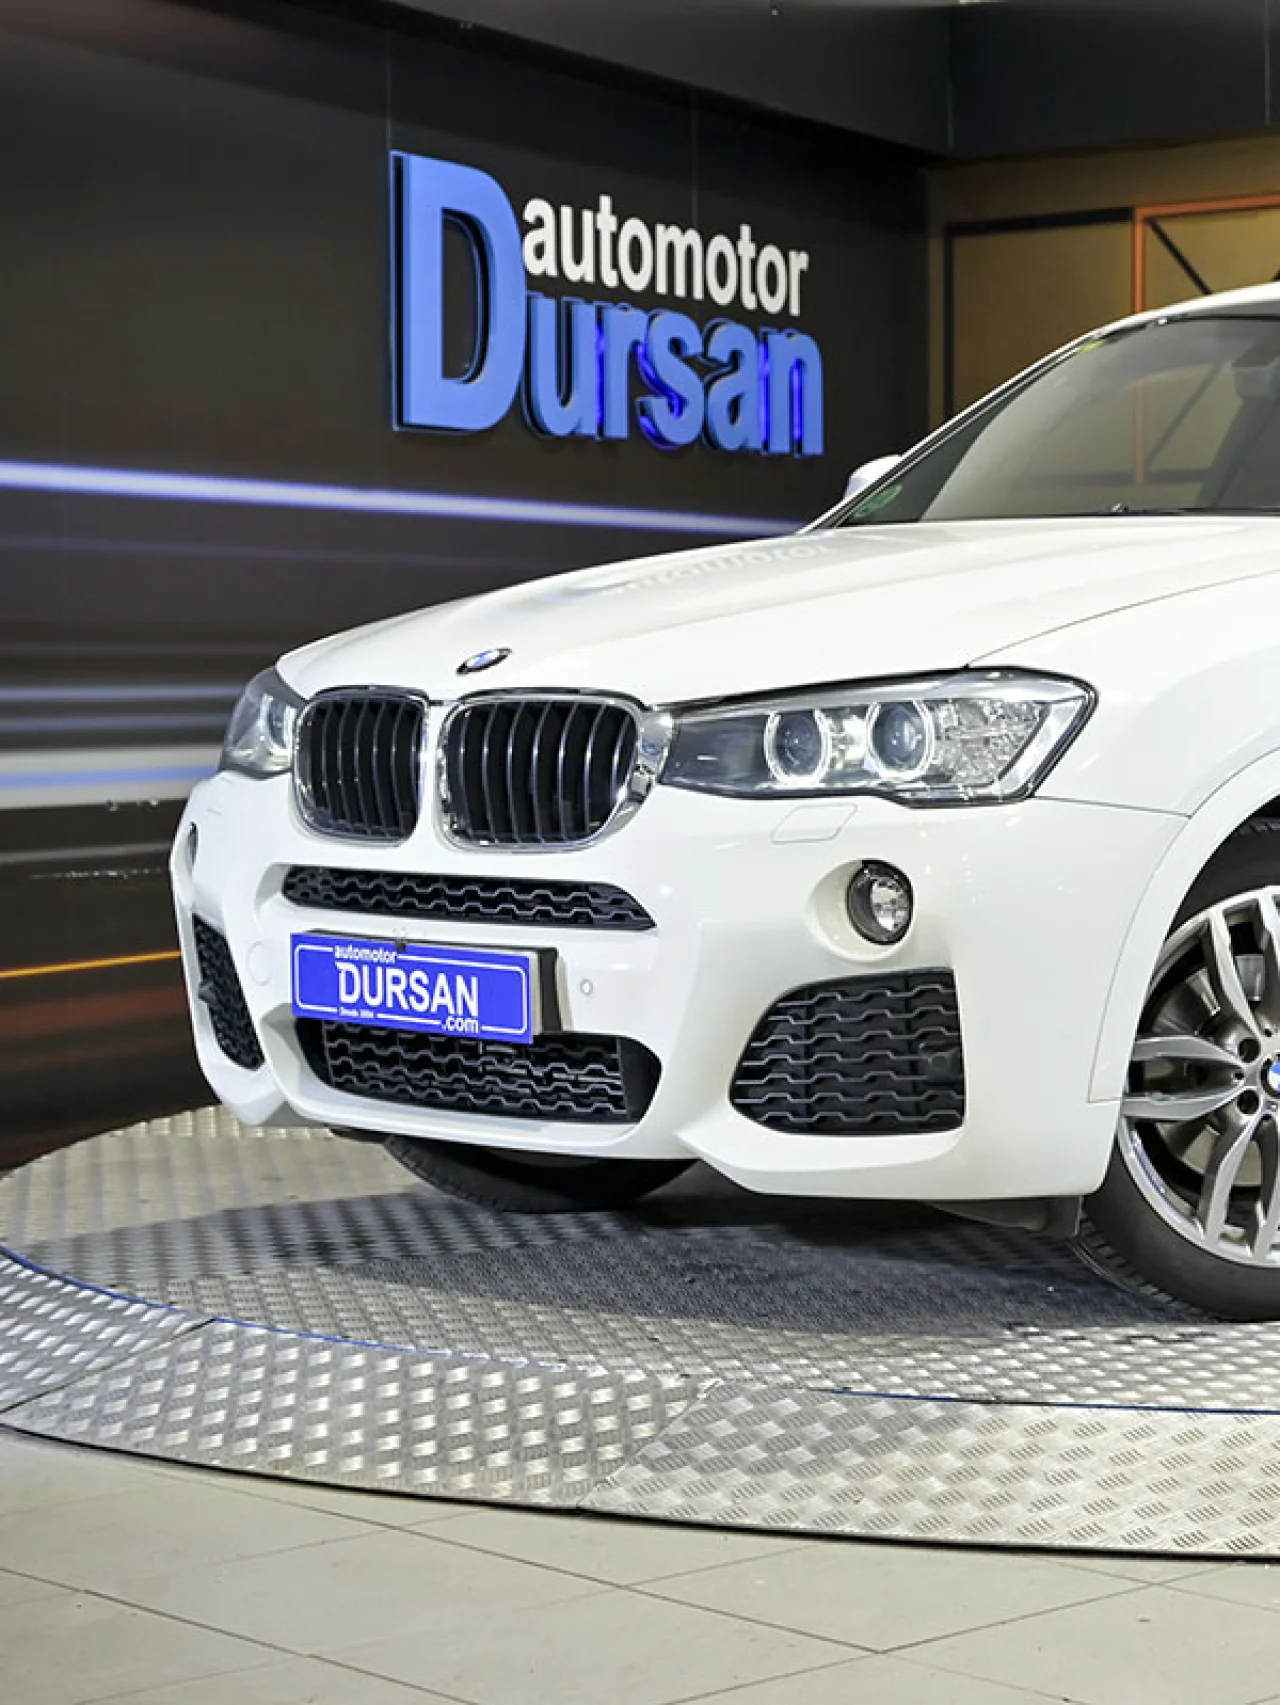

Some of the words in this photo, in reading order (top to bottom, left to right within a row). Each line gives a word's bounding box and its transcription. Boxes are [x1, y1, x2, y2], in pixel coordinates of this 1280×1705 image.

[522, 194, 809, 317] automotor
[389, 149, 825, 456] Dursan
[334, 944, 398, 964] automotor
[335, 961, 479, 1017] DURSAN
[441, 1015, 479, 1034] .com
